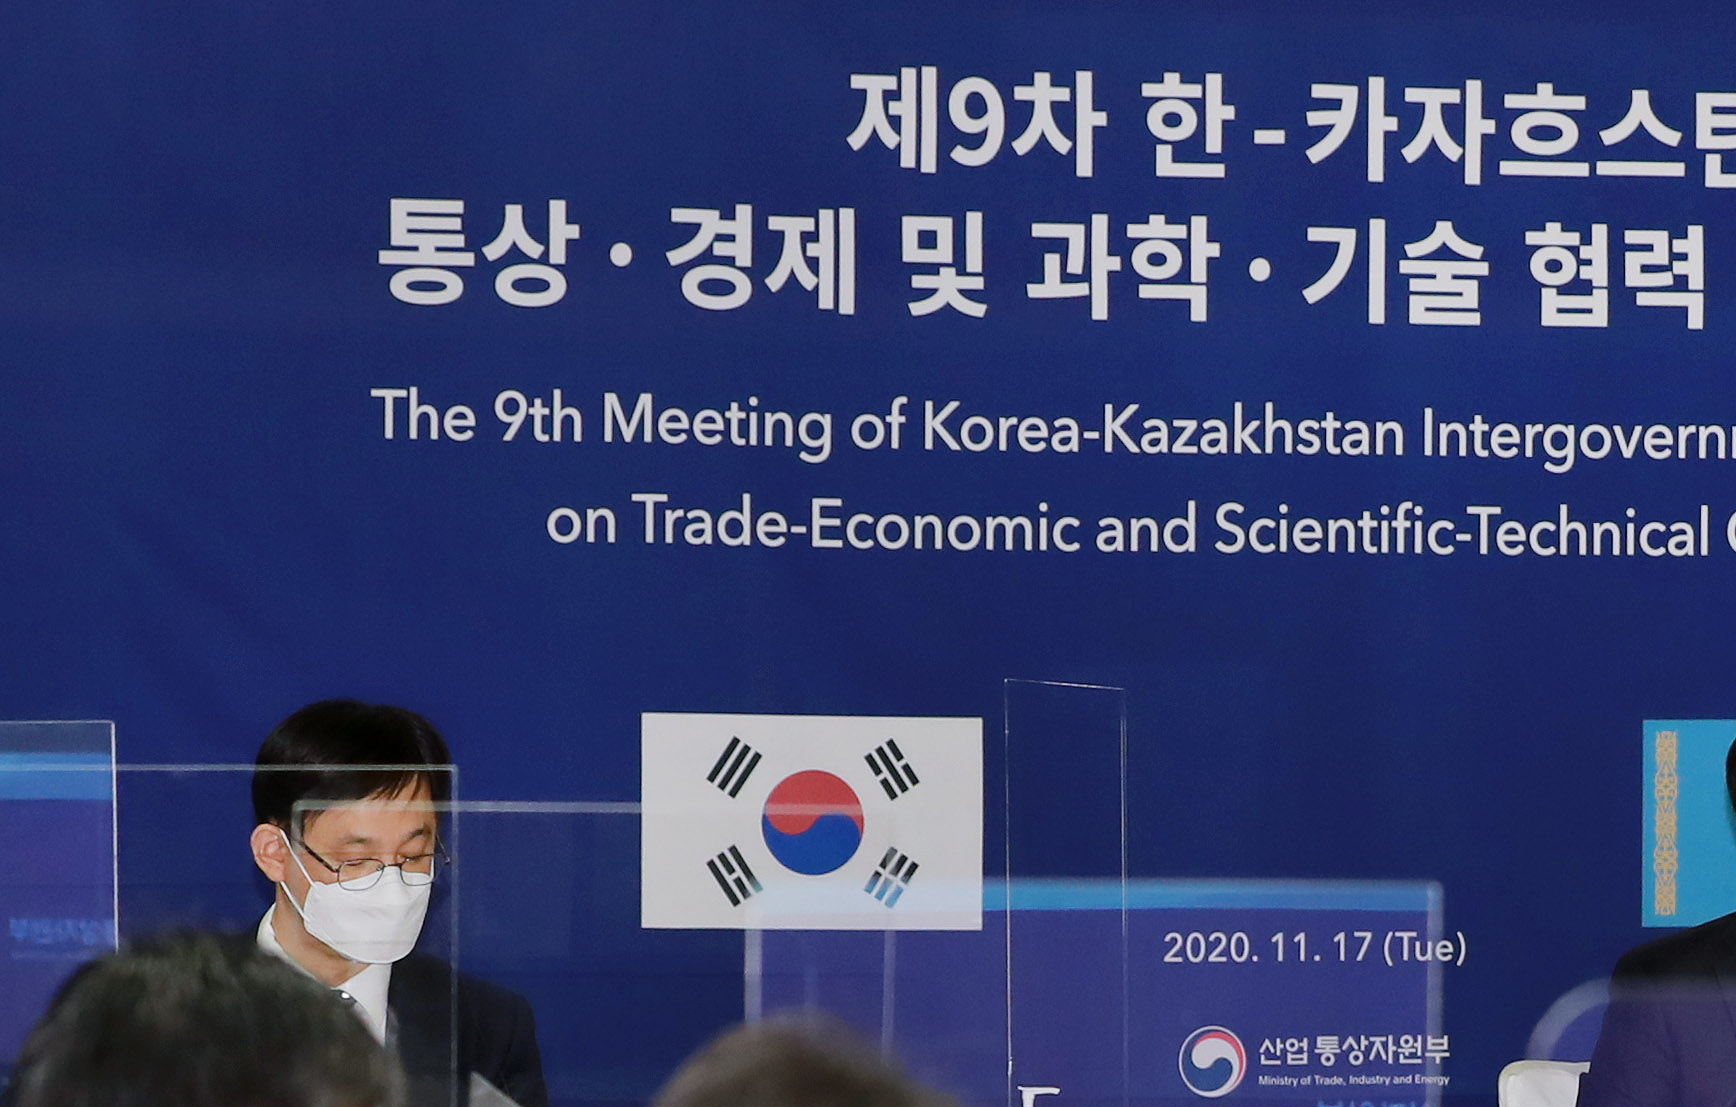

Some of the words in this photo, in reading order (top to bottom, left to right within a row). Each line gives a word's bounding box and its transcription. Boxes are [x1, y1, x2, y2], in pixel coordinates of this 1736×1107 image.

[845, 64, 1109, 179] 제9차
[900, 210, 989, 319] 및
[1524, 220, 1706, 331] 협력
[370, 386, 477, 443] The
[493, 388, 583, 444] 9th
[603, 392, 833, 465] Meeting
[850, 396, 909, 451] of
[923, 400, 1405, 457] Korea-Kazakhstan
[546, 506, 617, 545] on
[631, 492, 1082, 553] Trade-Economic
[1095, 500, 1197, 554] and
[1213, 501, 1710, 558] Scientific-Technical
[1162, 931, 1259, 964] 2020.
[1270, 931, 1322, 963] 11.
[1333, 930, 1373, 962] 17
[1383, 930, 1467, 968] (Tue)
[1258, 1075, 1299, 1087] Ministry
[1300, 1074, 1312, 1086] of
[1314, 1075, 1346, 1087] Trade,
[1349, 1074, 1391, 1086] Industry
[1392, 1074, 1413, 1085] and
[1414, 1073, 1451, 1087] Energy
